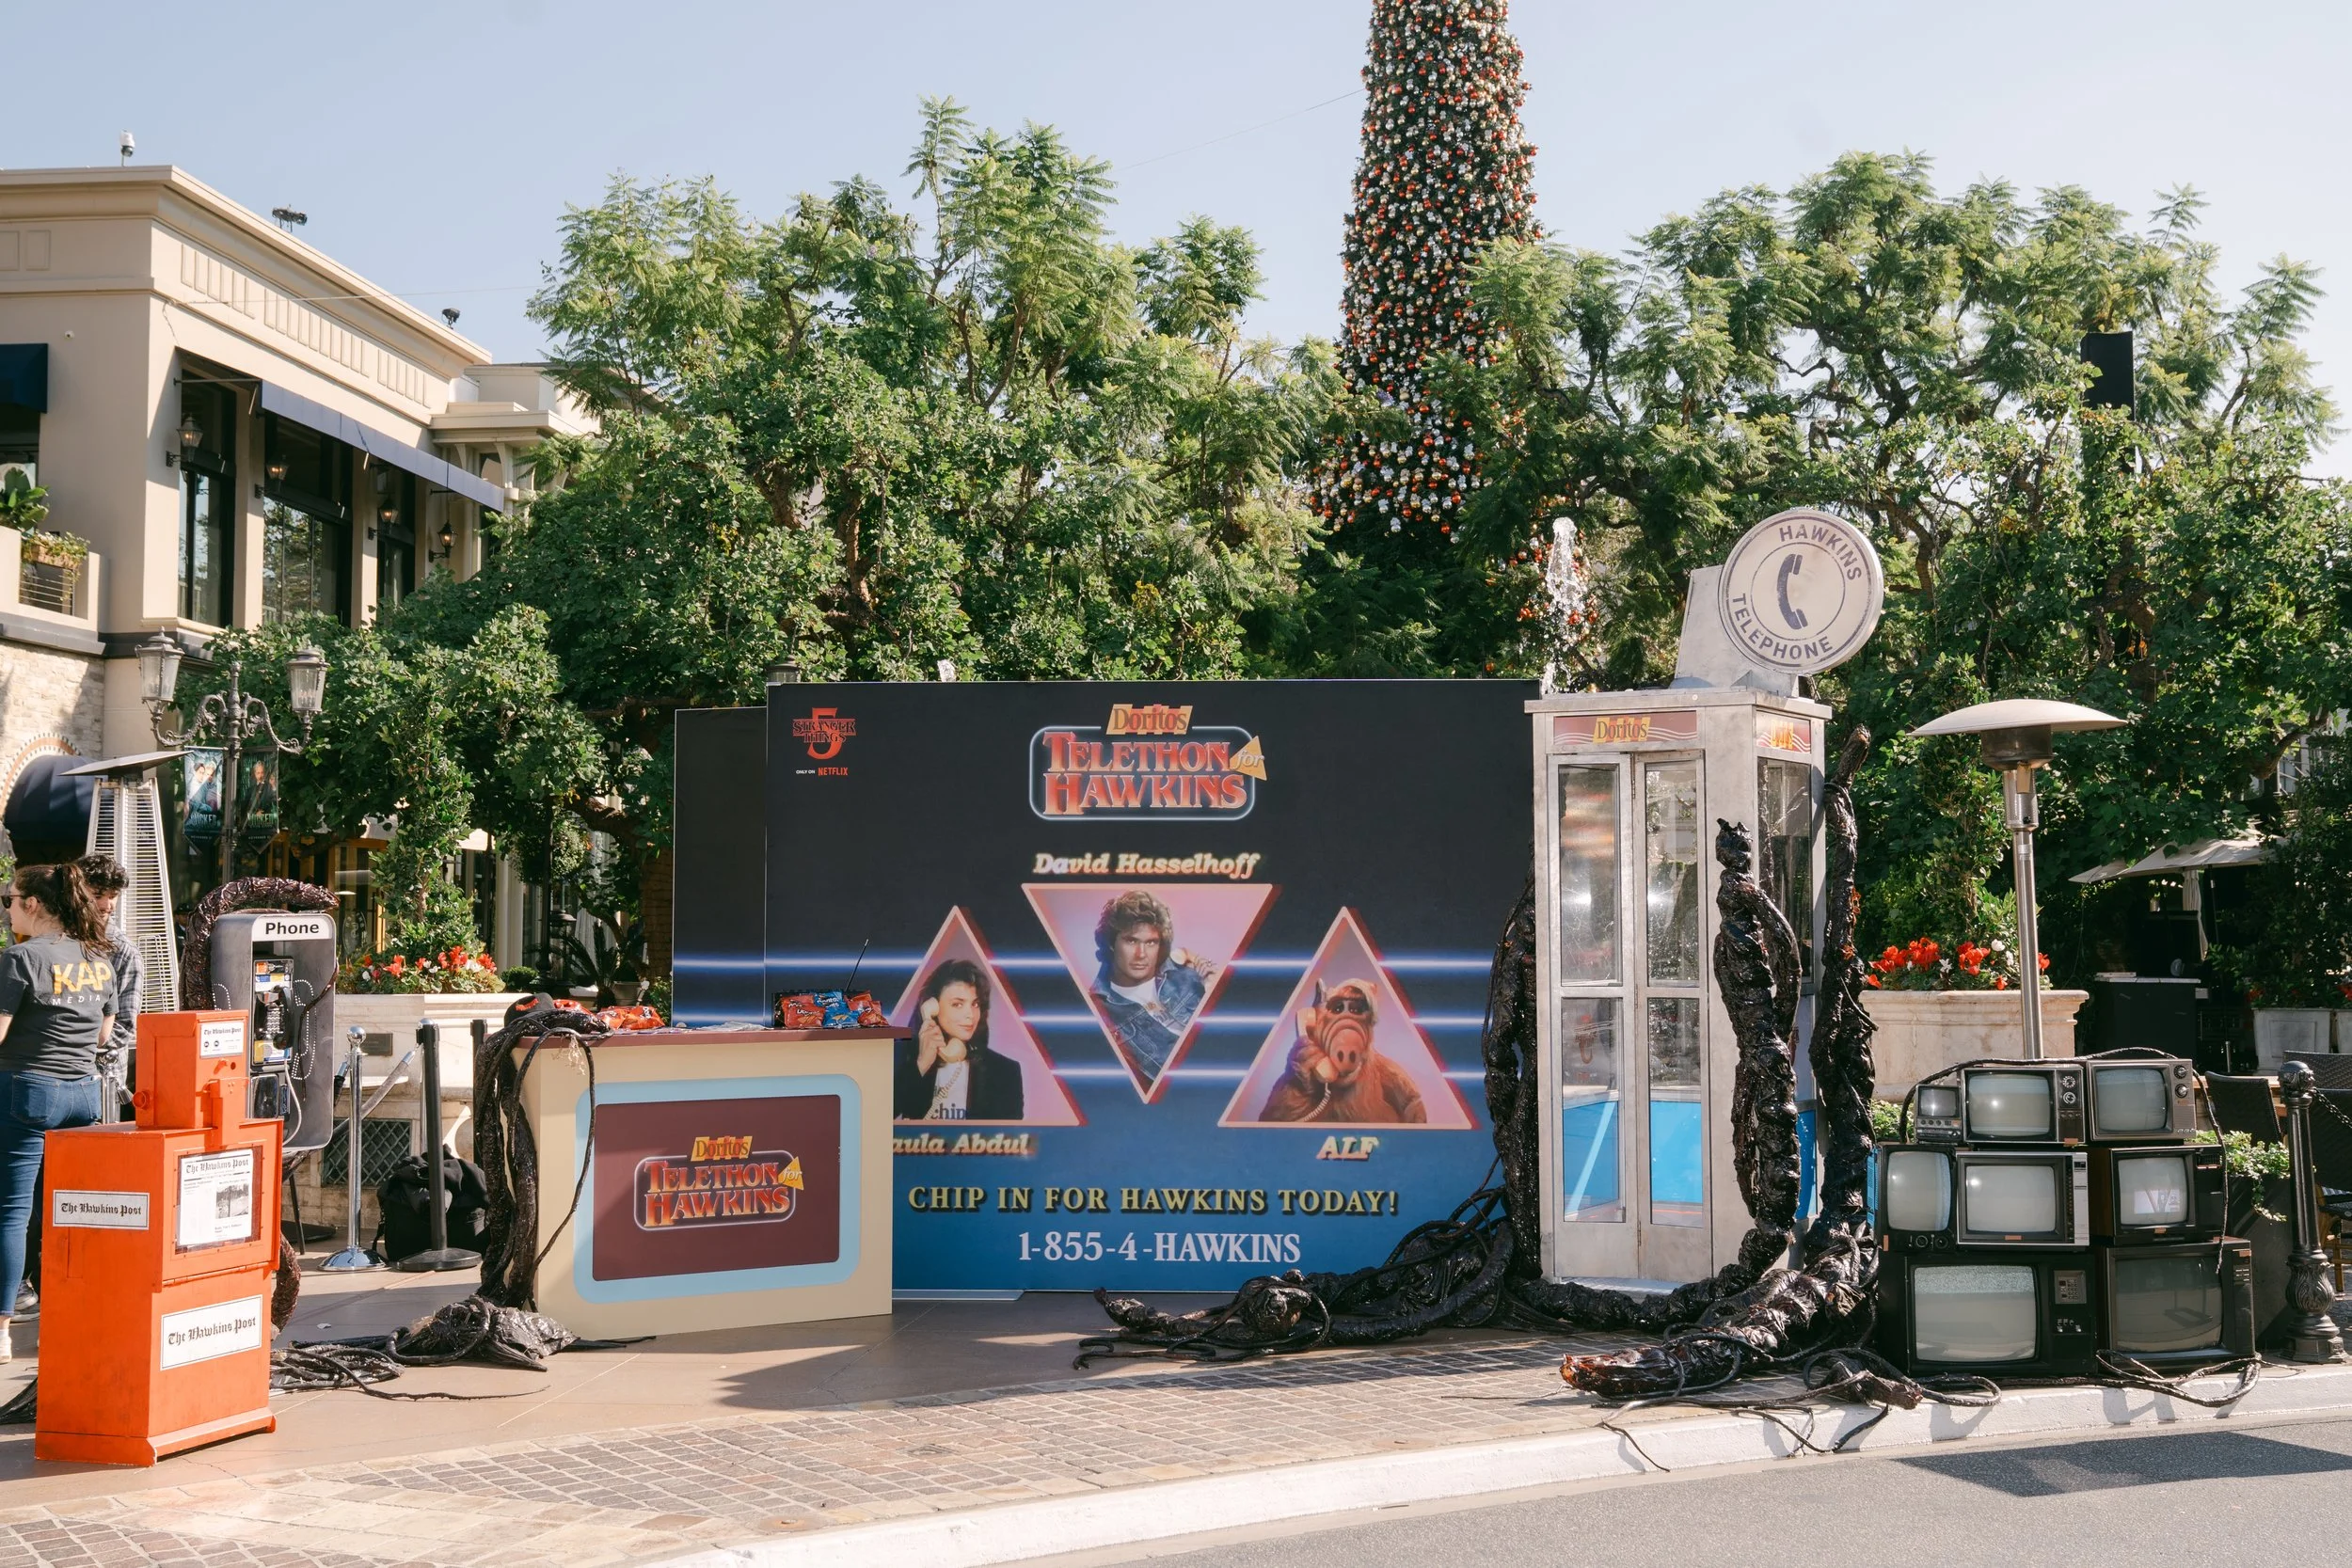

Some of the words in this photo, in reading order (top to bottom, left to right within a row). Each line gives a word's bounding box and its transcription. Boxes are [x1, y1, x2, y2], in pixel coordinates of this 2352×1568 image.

[1779, 524, 1862, 580] HAWKINS
[1732, 593, 1833, 659] TELEPHONE
[793, 721, 856, 734] STRANGER
[1113, 707, 1187, 731] Doritos
[1597, 721, 1647, 740] Doritos
[803, 733, 846, 743] THINGS
[1042, 731, 1232, 772] TELETHON
[1234, 749, 1265, 769] for
[818, 767, 849, 776] NETFLIX
[1042, 772, 1248, 816] HAWKINS
[1033, 852, 1111, 875] David
[1116, 852, 1262, 879] Hasselhoff
[265, 922, 320, 935] Phone
[53, 960, 112, 994] KAP
[52, 994, 102, 1006] MEDIA
[695, 1136, 749, 1158] Doritos
[893, 1132, 946, 1154] aula
[950, 1132, 1029, 1155] Abdul
[1315, 1135, 1379, 1160] ALF
[185, 1164, 199, 1174] The
[199, 1160, 231, 1171] Hawkins
[232, 1158, 249, 1169] Post
[644, 1161, 780, 1194] TELETHON
[782, 1167, 803, 1181] for
[61, 1202, 78, 1214] The
[79, 1203, 119, 1214] Hawkins
[119, 1204, 142, 1217] Post
[644, 1186, 791, 1227] HAWKINS
[908, 1186, 985, 1210] CHIP
[997, 1187, 1030, 1211] IN
[1044, 1187, 1107, 1211] FOR
[1120, 1187, 1265, 1212] HAWKINS
[1278, 1189, 1396, 1212] TODAY!
[168, 1332, 185, 1346] The
[188, 1323, 233, 1341] Hawkins
[233, 1317, 257, 1334] Post
